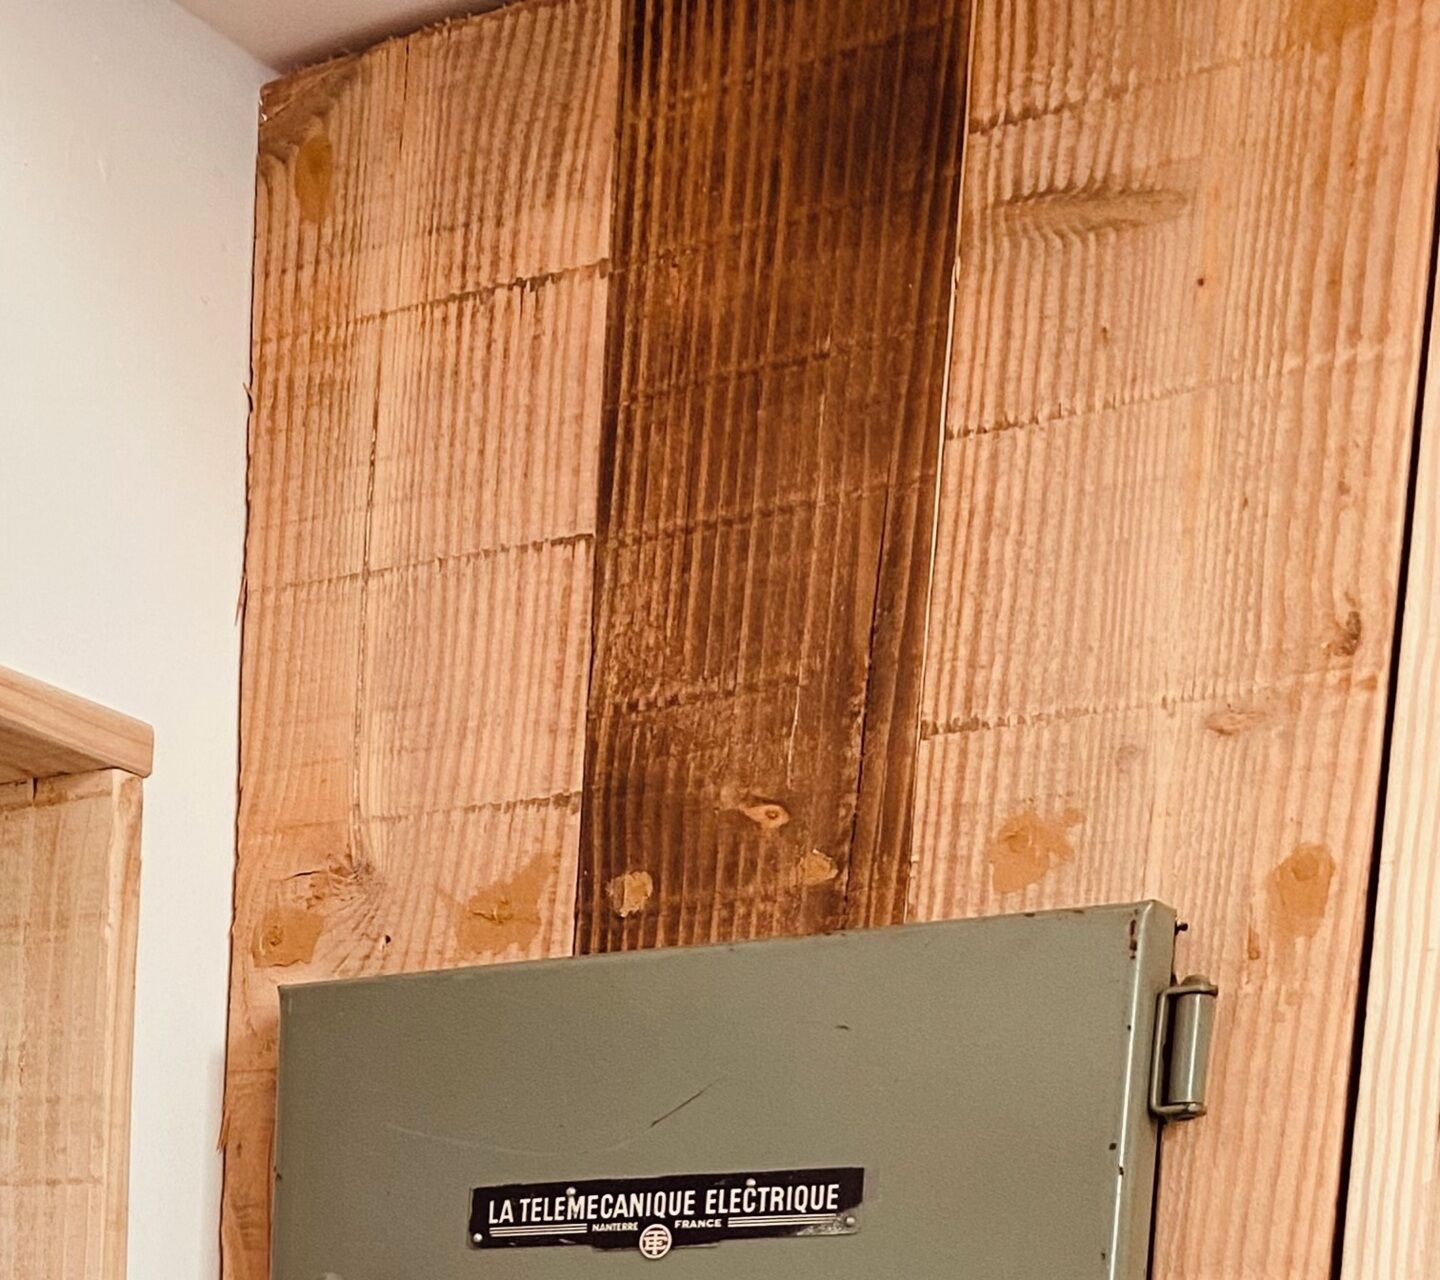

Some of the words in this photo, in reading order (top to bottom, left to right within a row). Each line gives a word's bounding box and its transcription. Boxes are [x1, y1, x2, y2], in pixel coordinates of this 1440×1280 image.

[488, 1199, 514, 1224] LA
[520, 1190, 696, 1223] TELEMECANIQUE
[705, 1183, 840, 1215] ELECTRIQUE
[591, 1221, 639, 1232] NANTERRE
[674, 1218, 722, 1229] FRANCE
